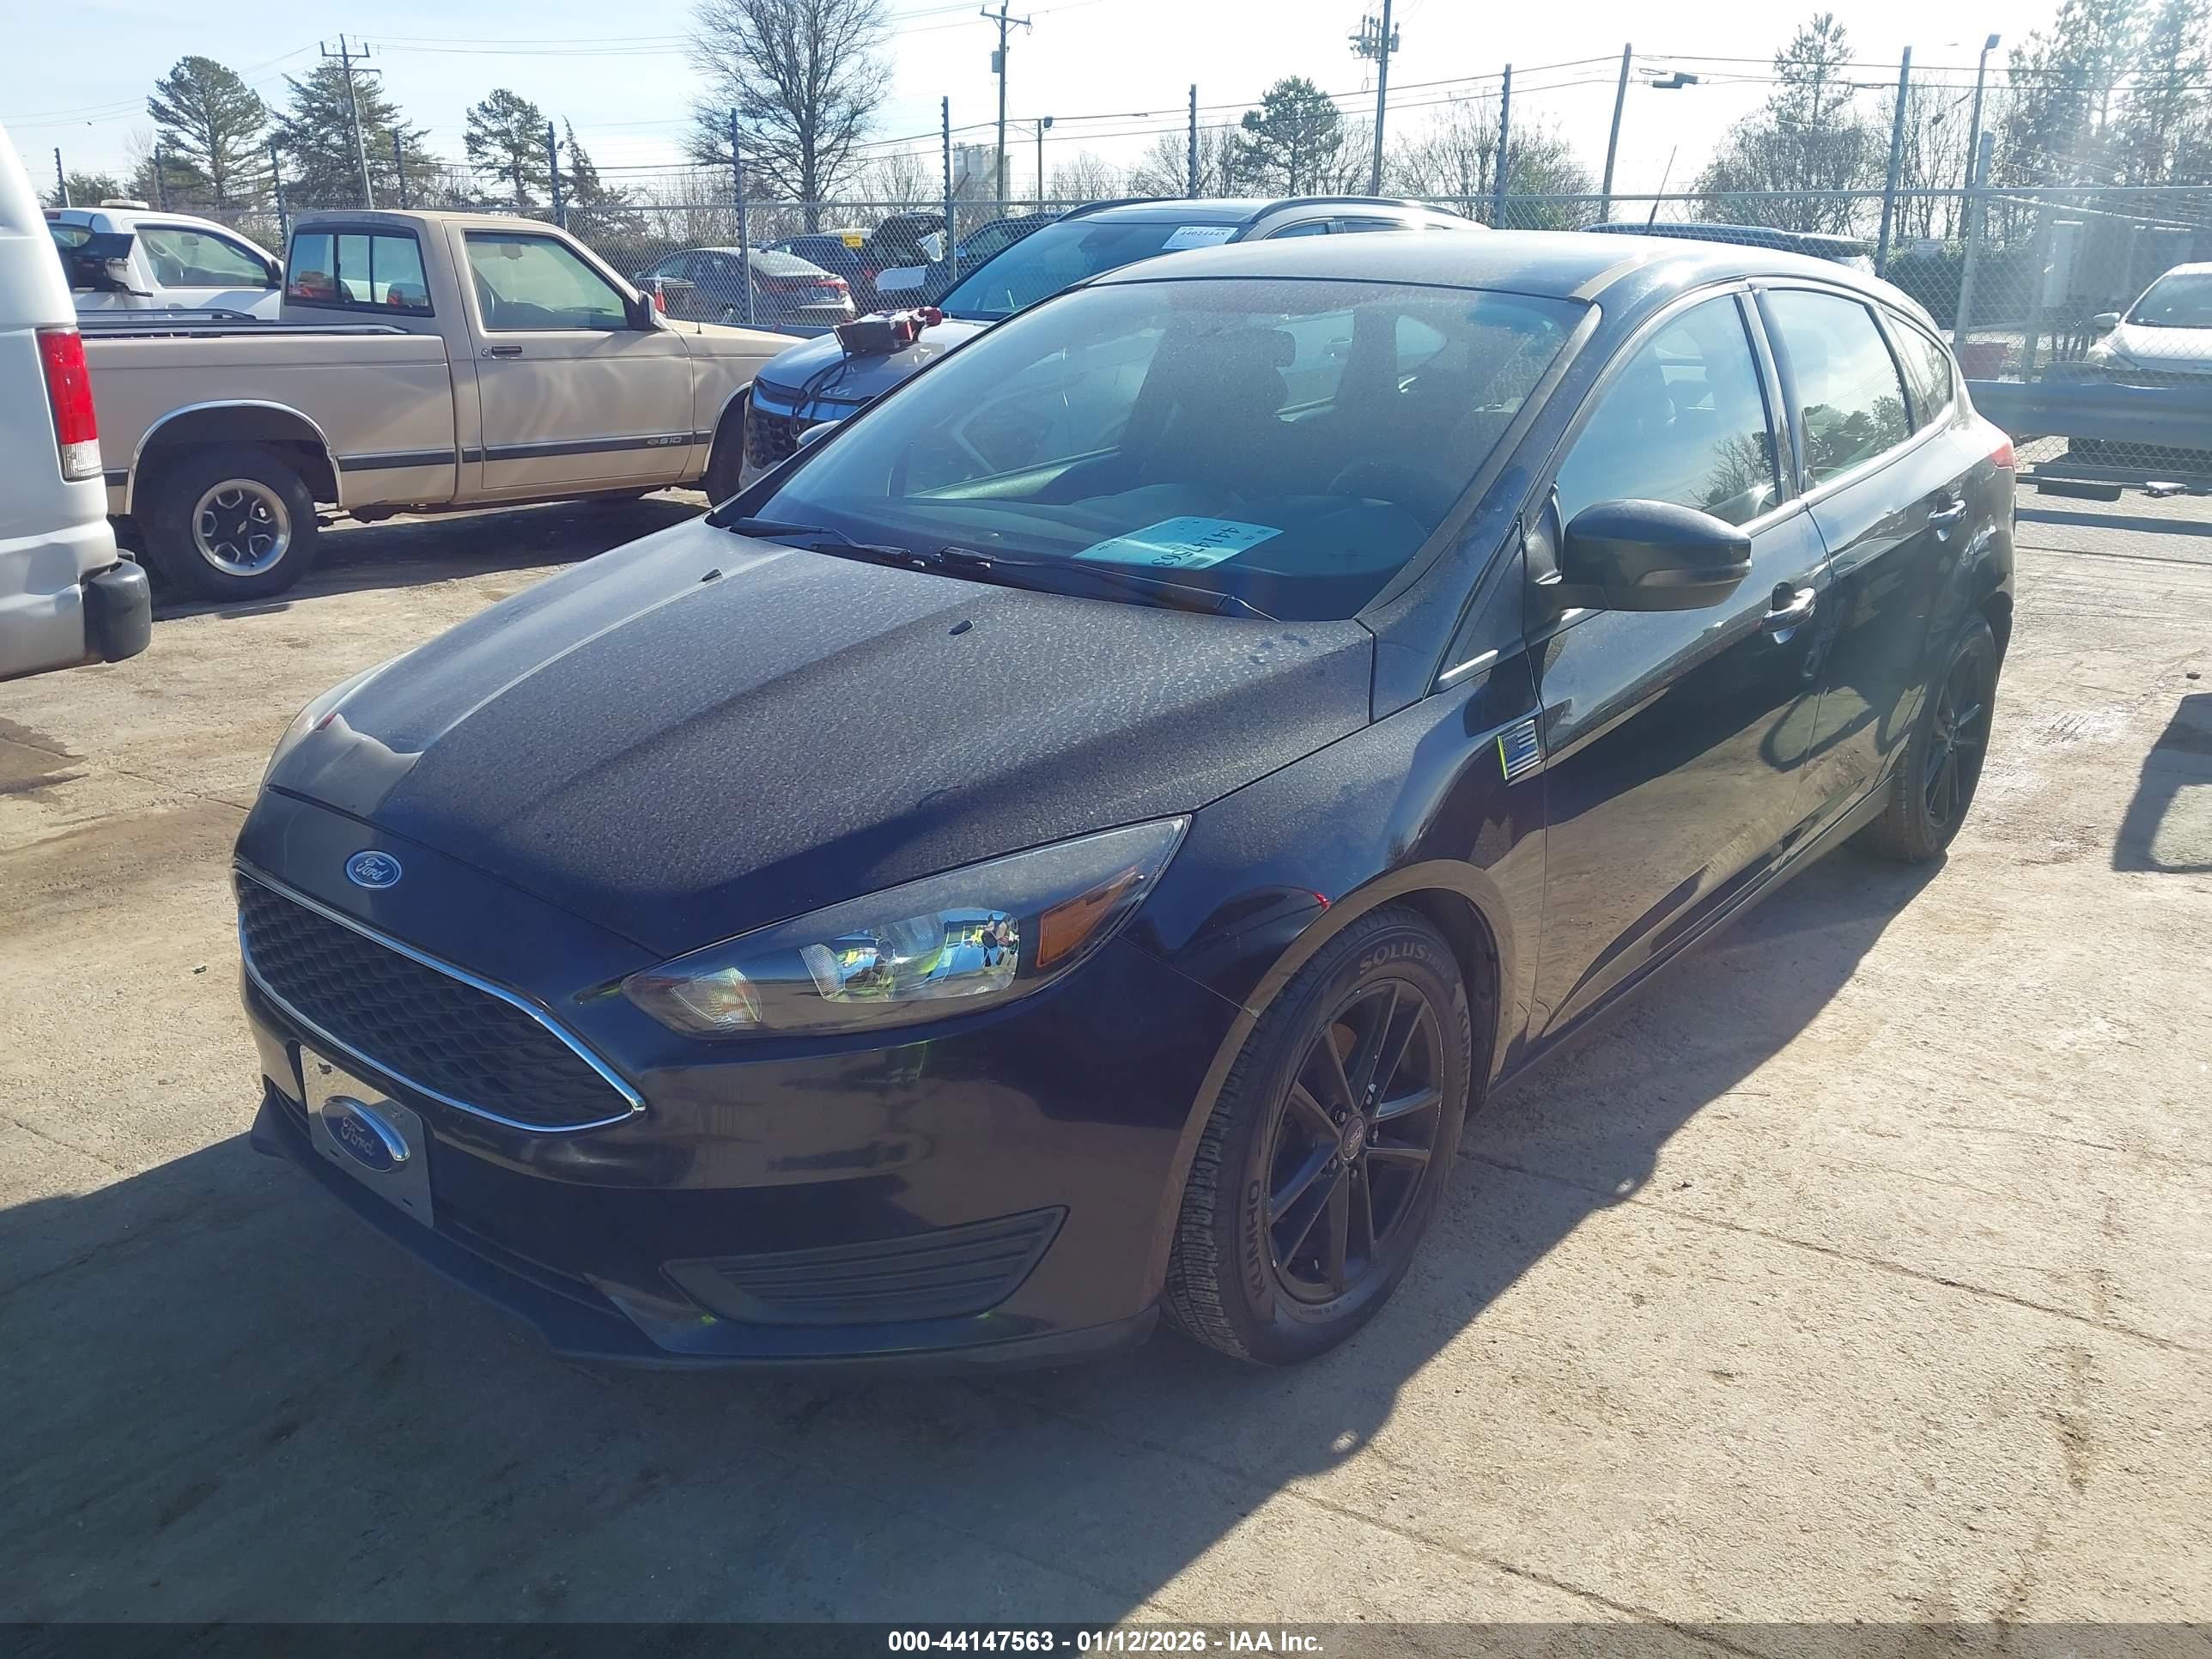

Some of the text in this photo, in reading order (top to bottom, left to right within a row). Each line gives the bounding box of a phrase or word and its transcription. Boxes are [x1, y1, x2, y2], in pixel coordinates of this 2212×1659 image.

[1151, 526, 1241, 566] 44147563
[355, 856, 389, 881] Ford
[1359, 941, 1428, 975] SOLUS
[340, 1115, 378, 1158] Ford
[1244, 1179, 1267, 1301] KUMHO
